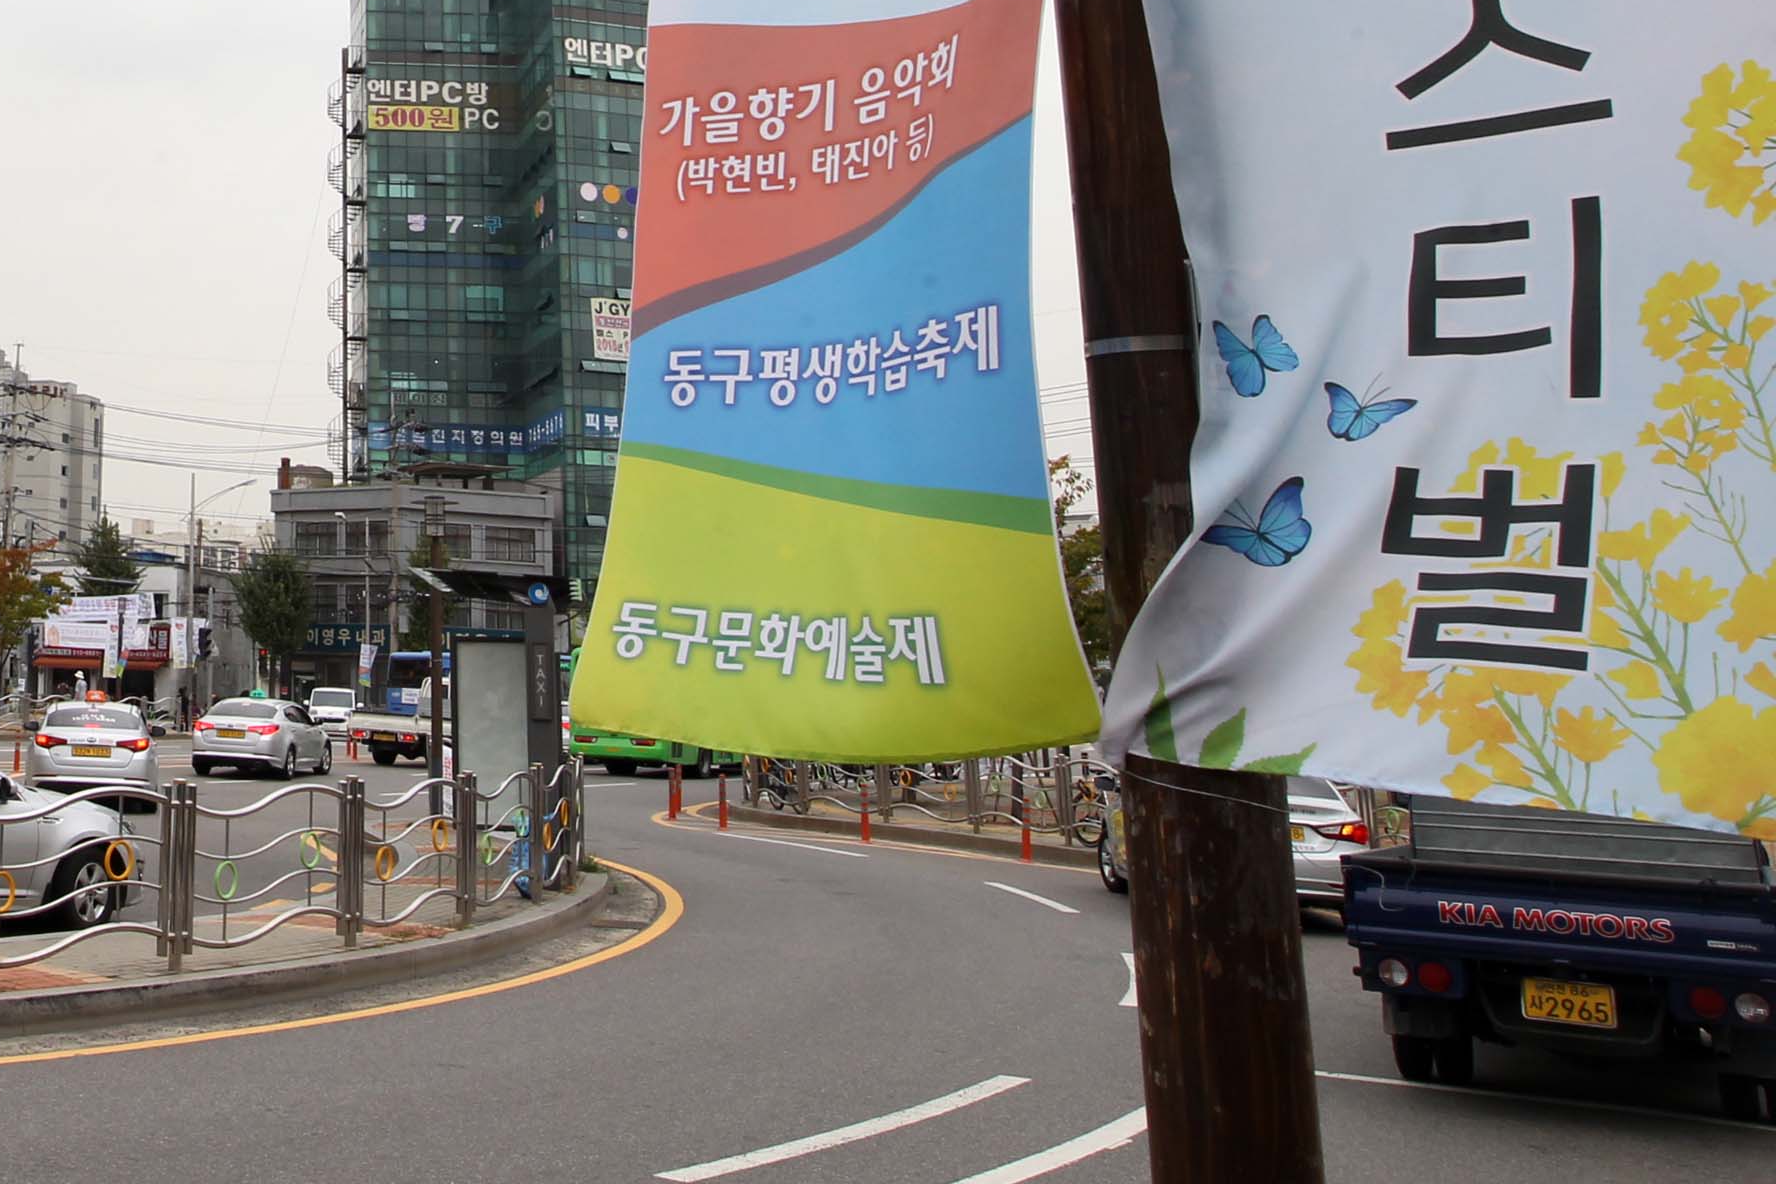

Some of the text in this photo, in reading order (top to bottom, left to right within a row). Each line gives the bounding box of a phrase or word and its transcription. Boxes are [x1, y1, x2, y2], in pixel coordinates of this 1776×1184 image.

[366, 78, 489, 105] 엔터PC방
[374, 106, 500, 130] 500원 PC
[658, 34, 960, 147] 가을향기 음악회
[676, 113, 935, 202] (박현빈, 태진아 등)
[662, 305, 1001, 408] 동구평생학습축제
[610, 600, 947, 686] 동구문화예술제
[535, 654, 547, 707] TAXI
[1437, 900, 1676, 944] KIA MOTORS
